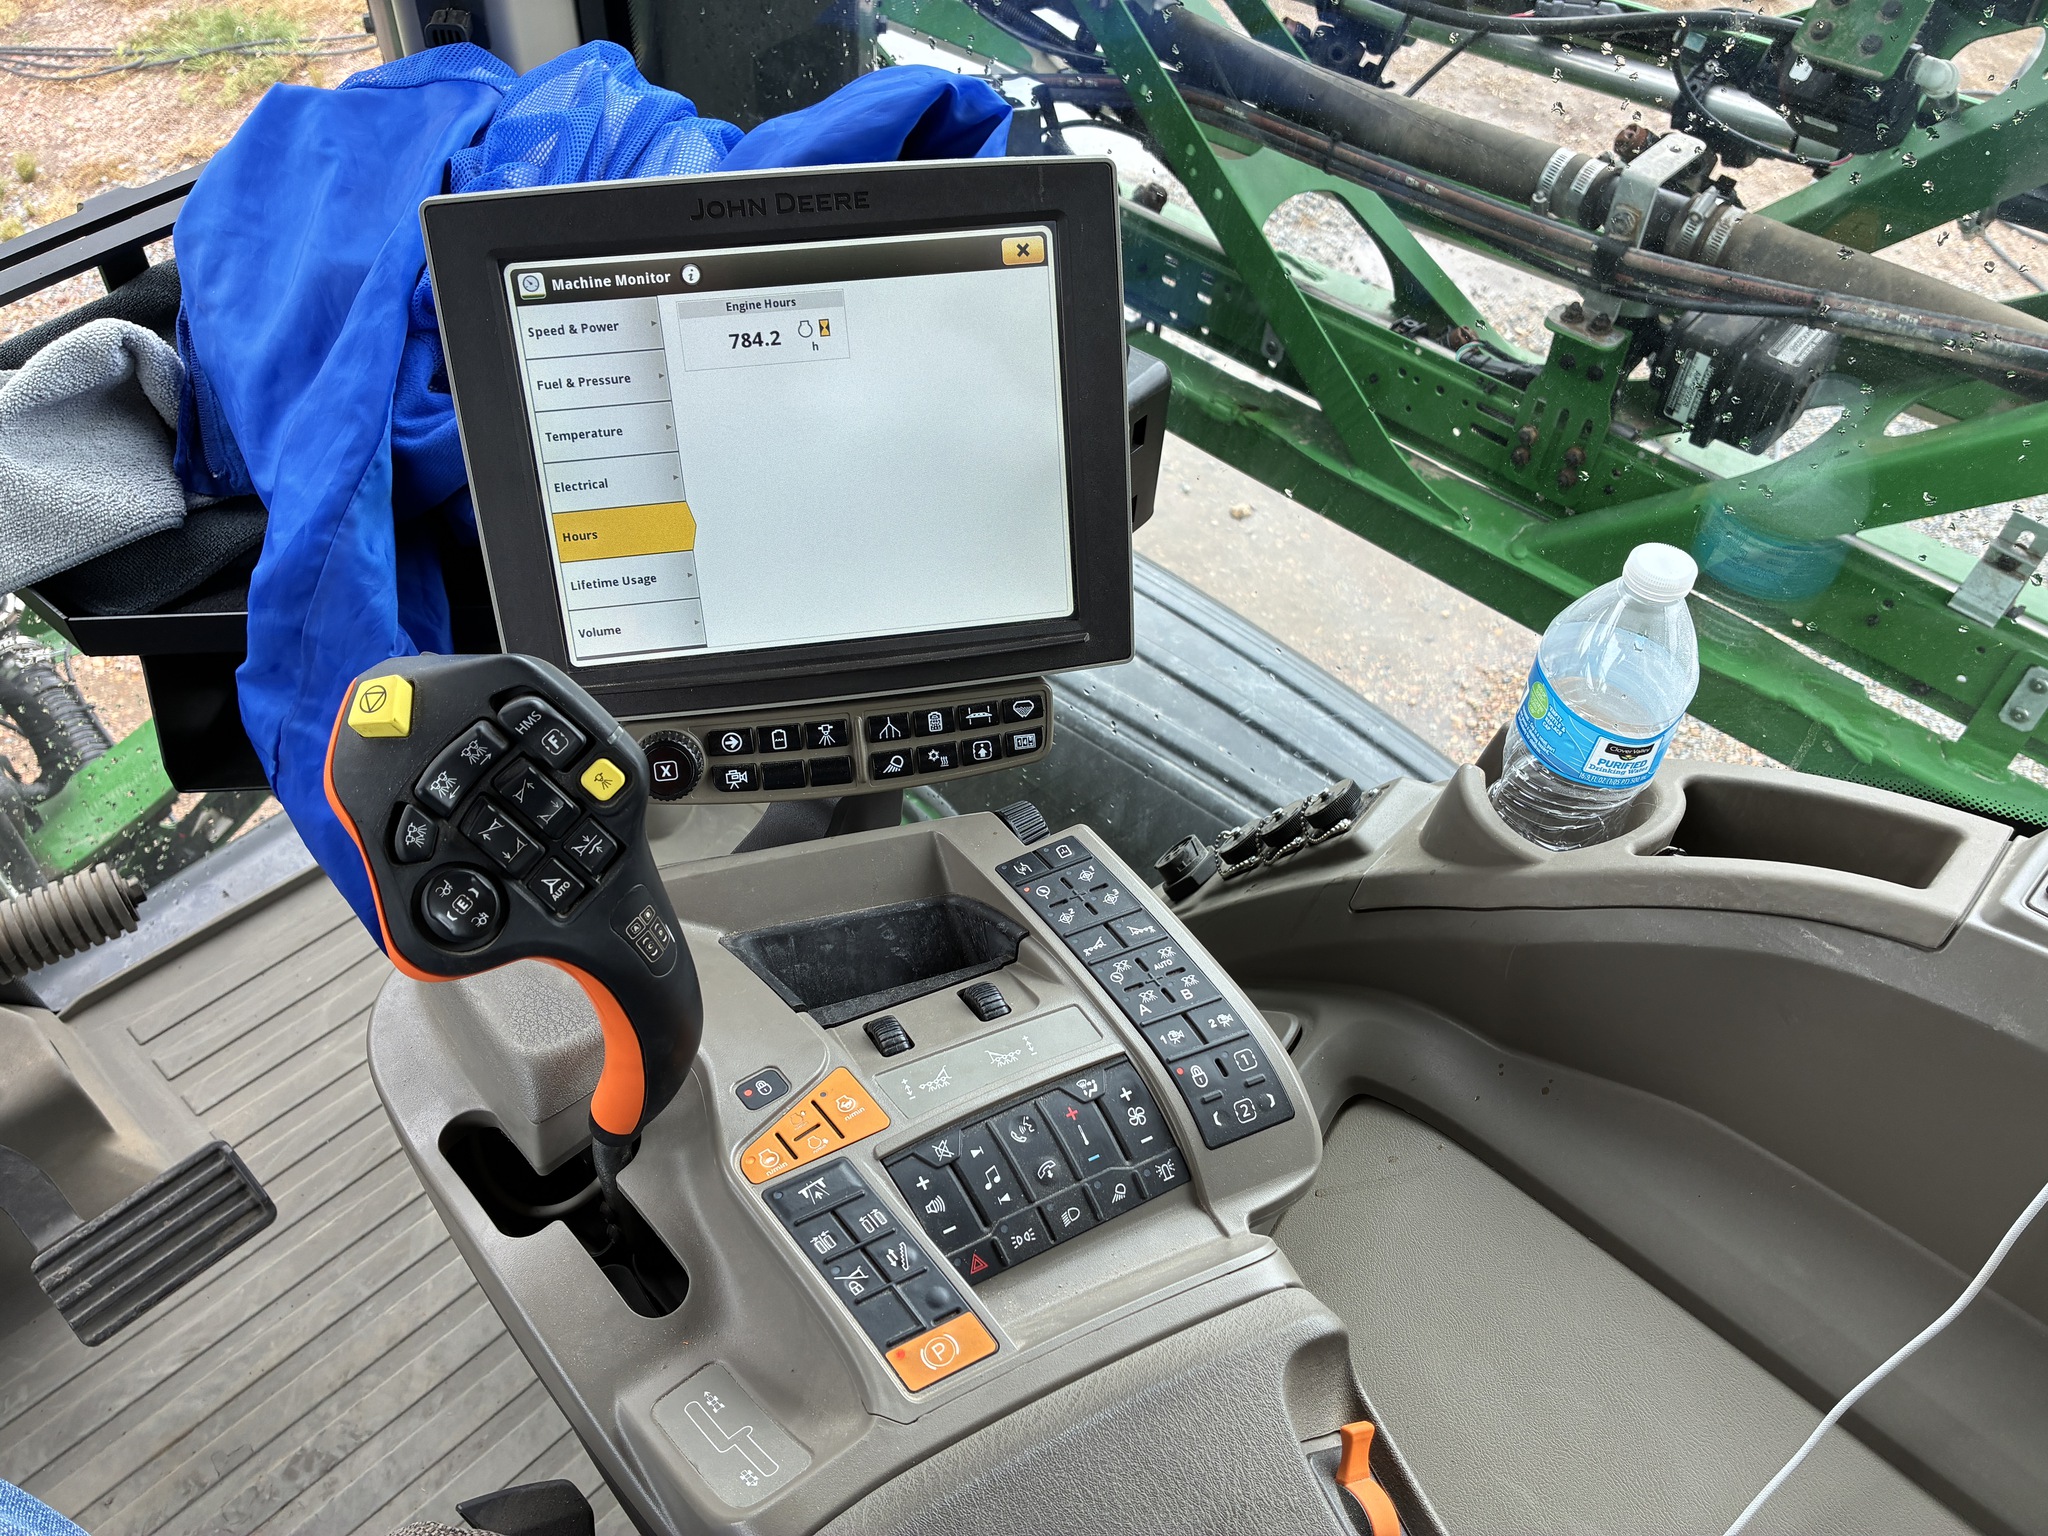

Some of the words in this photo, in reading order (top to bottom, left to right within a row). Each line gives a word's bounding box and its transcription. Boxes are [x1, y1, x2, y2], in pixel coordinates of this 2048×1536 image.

[690, 197, 767, 222] JOHN
[775, 190, 870, 215] DEERE
[551, 277, 612, 292] Machine
[615, 271, 671, 286] Monitor
[725, 299, 762, 315] Engine
[764, 297, 796, 309] Hours
[528, 324, 565, 340] Speed
[569, 324, 578, 334] &
[581, 322, 619, 334] Power
[728, 330, 782, 349] 784.2
[812, 341, 819, 351] h
[537, 378, 562, 391] Fuel
[566, 378, 575, 388] &
[578, 374, 631, 387] Pressure
[545, 427, 623, 442] Temperature
[554, 478, 608, 493] Electrical
[562, 530, 598, 542] Hours
[570, 577, 619, 591] Lifetime
[622, 574, 657, 587] Usage
[578, 626, 622, 638] Volume
[515, 710, 542, 735] HMS
[1609, 746, 1632, 755] Clover
[1633, 747, 1651, 755] Valley
[1588, 763, 1626, 775] Drinking
[1628, 766, 1649, 774] Water
[1597, 758, 1648, 770] PURIFIED
[551, 881, 571, 902] AUTO
[1153, 959, 1173, 970] AUTO
[1180, 988, 1194, 1000] B
[1139, 1003, 1152, 1016] A
[1208, 1018, 1218, 1029] 2
[1160, 1034, 1168, 1045] 1
[844, 1106, 866, 1121] n/min
[765, 1160, 789, 1176] n/min
